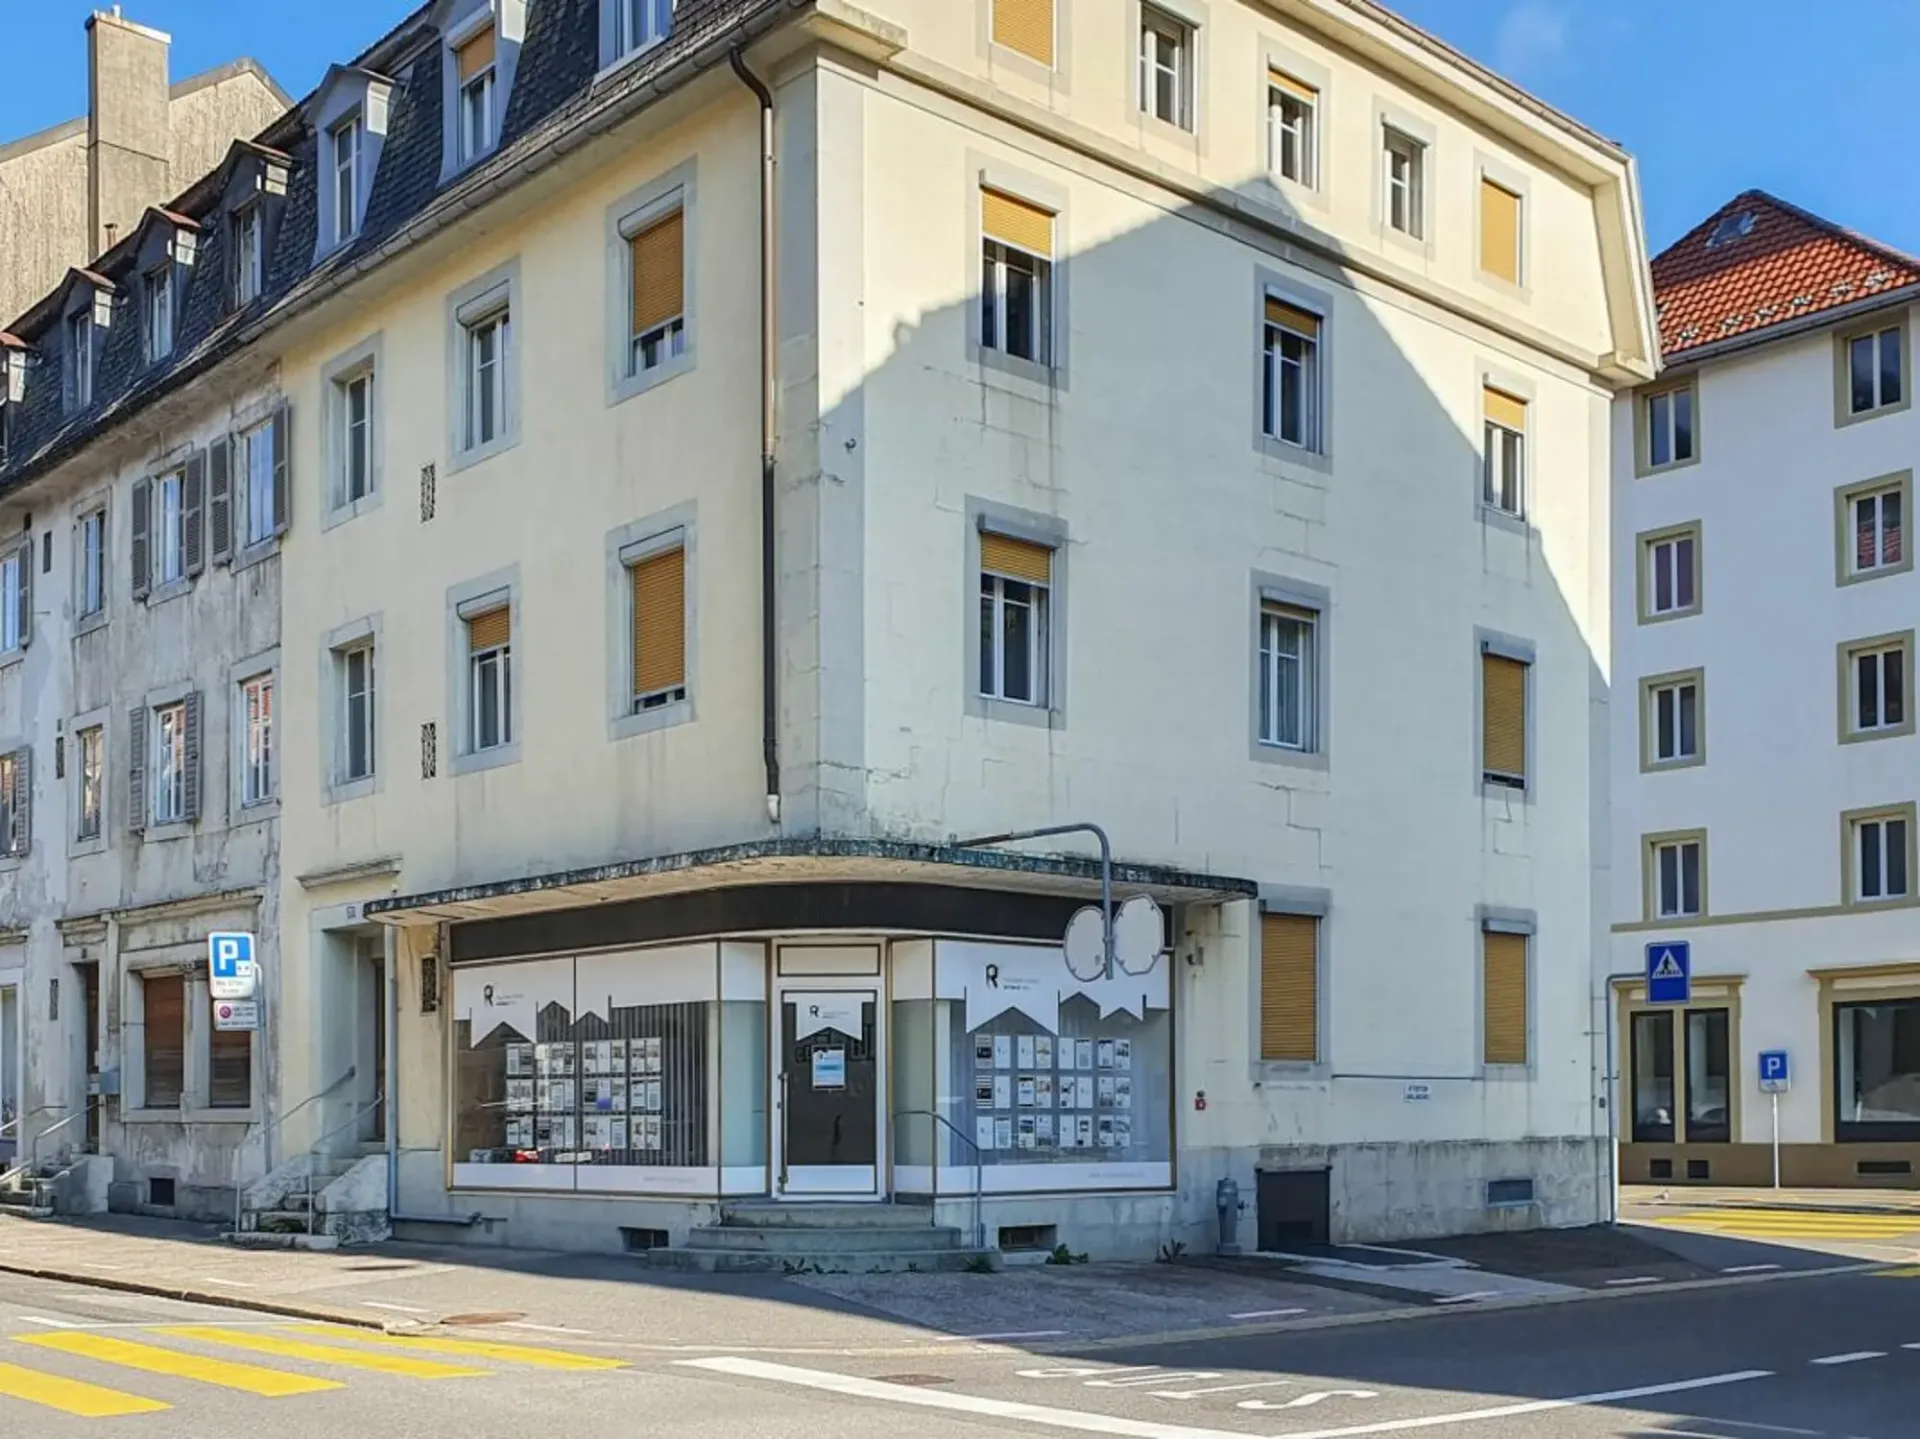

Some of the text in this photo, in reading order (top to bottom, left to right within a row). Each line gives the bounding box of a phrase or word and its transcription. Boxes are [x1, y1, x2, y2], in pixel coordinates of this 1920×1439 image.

[218, 940, 239, 971] P
[985, 963, 998, 990] R
[483, 984, 494, 1008] R
[1767, 1057, 1781, 1077] P
